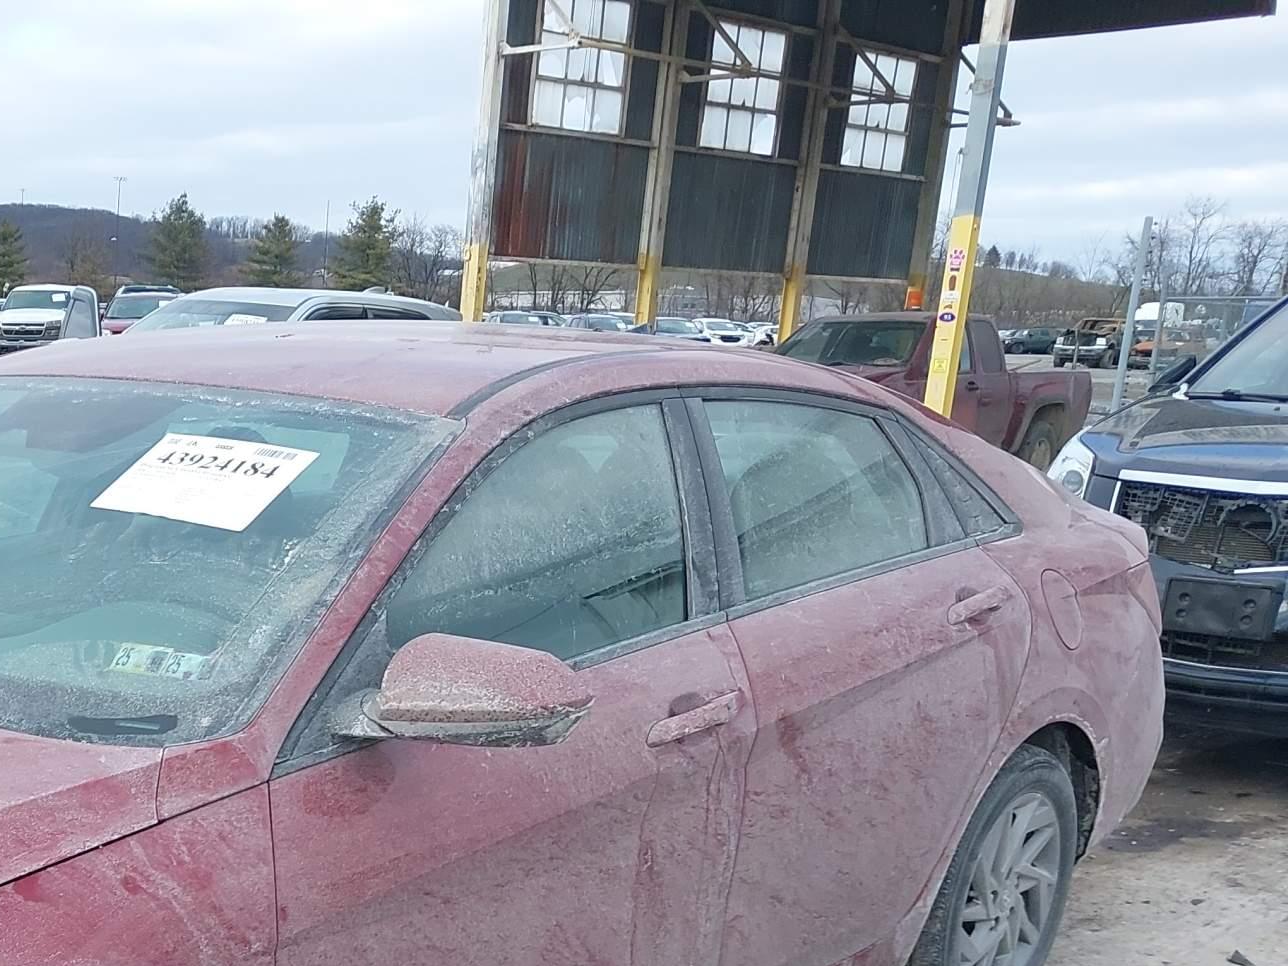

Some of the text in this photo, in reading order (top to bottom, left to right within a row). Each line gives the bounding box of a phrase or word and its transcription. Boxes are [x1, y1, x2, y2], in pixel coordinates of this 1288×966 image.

[156, 450, 281, 479] 43924184
[115, 647, 134, 666] 25
[165, 655, 186, 674] 25
